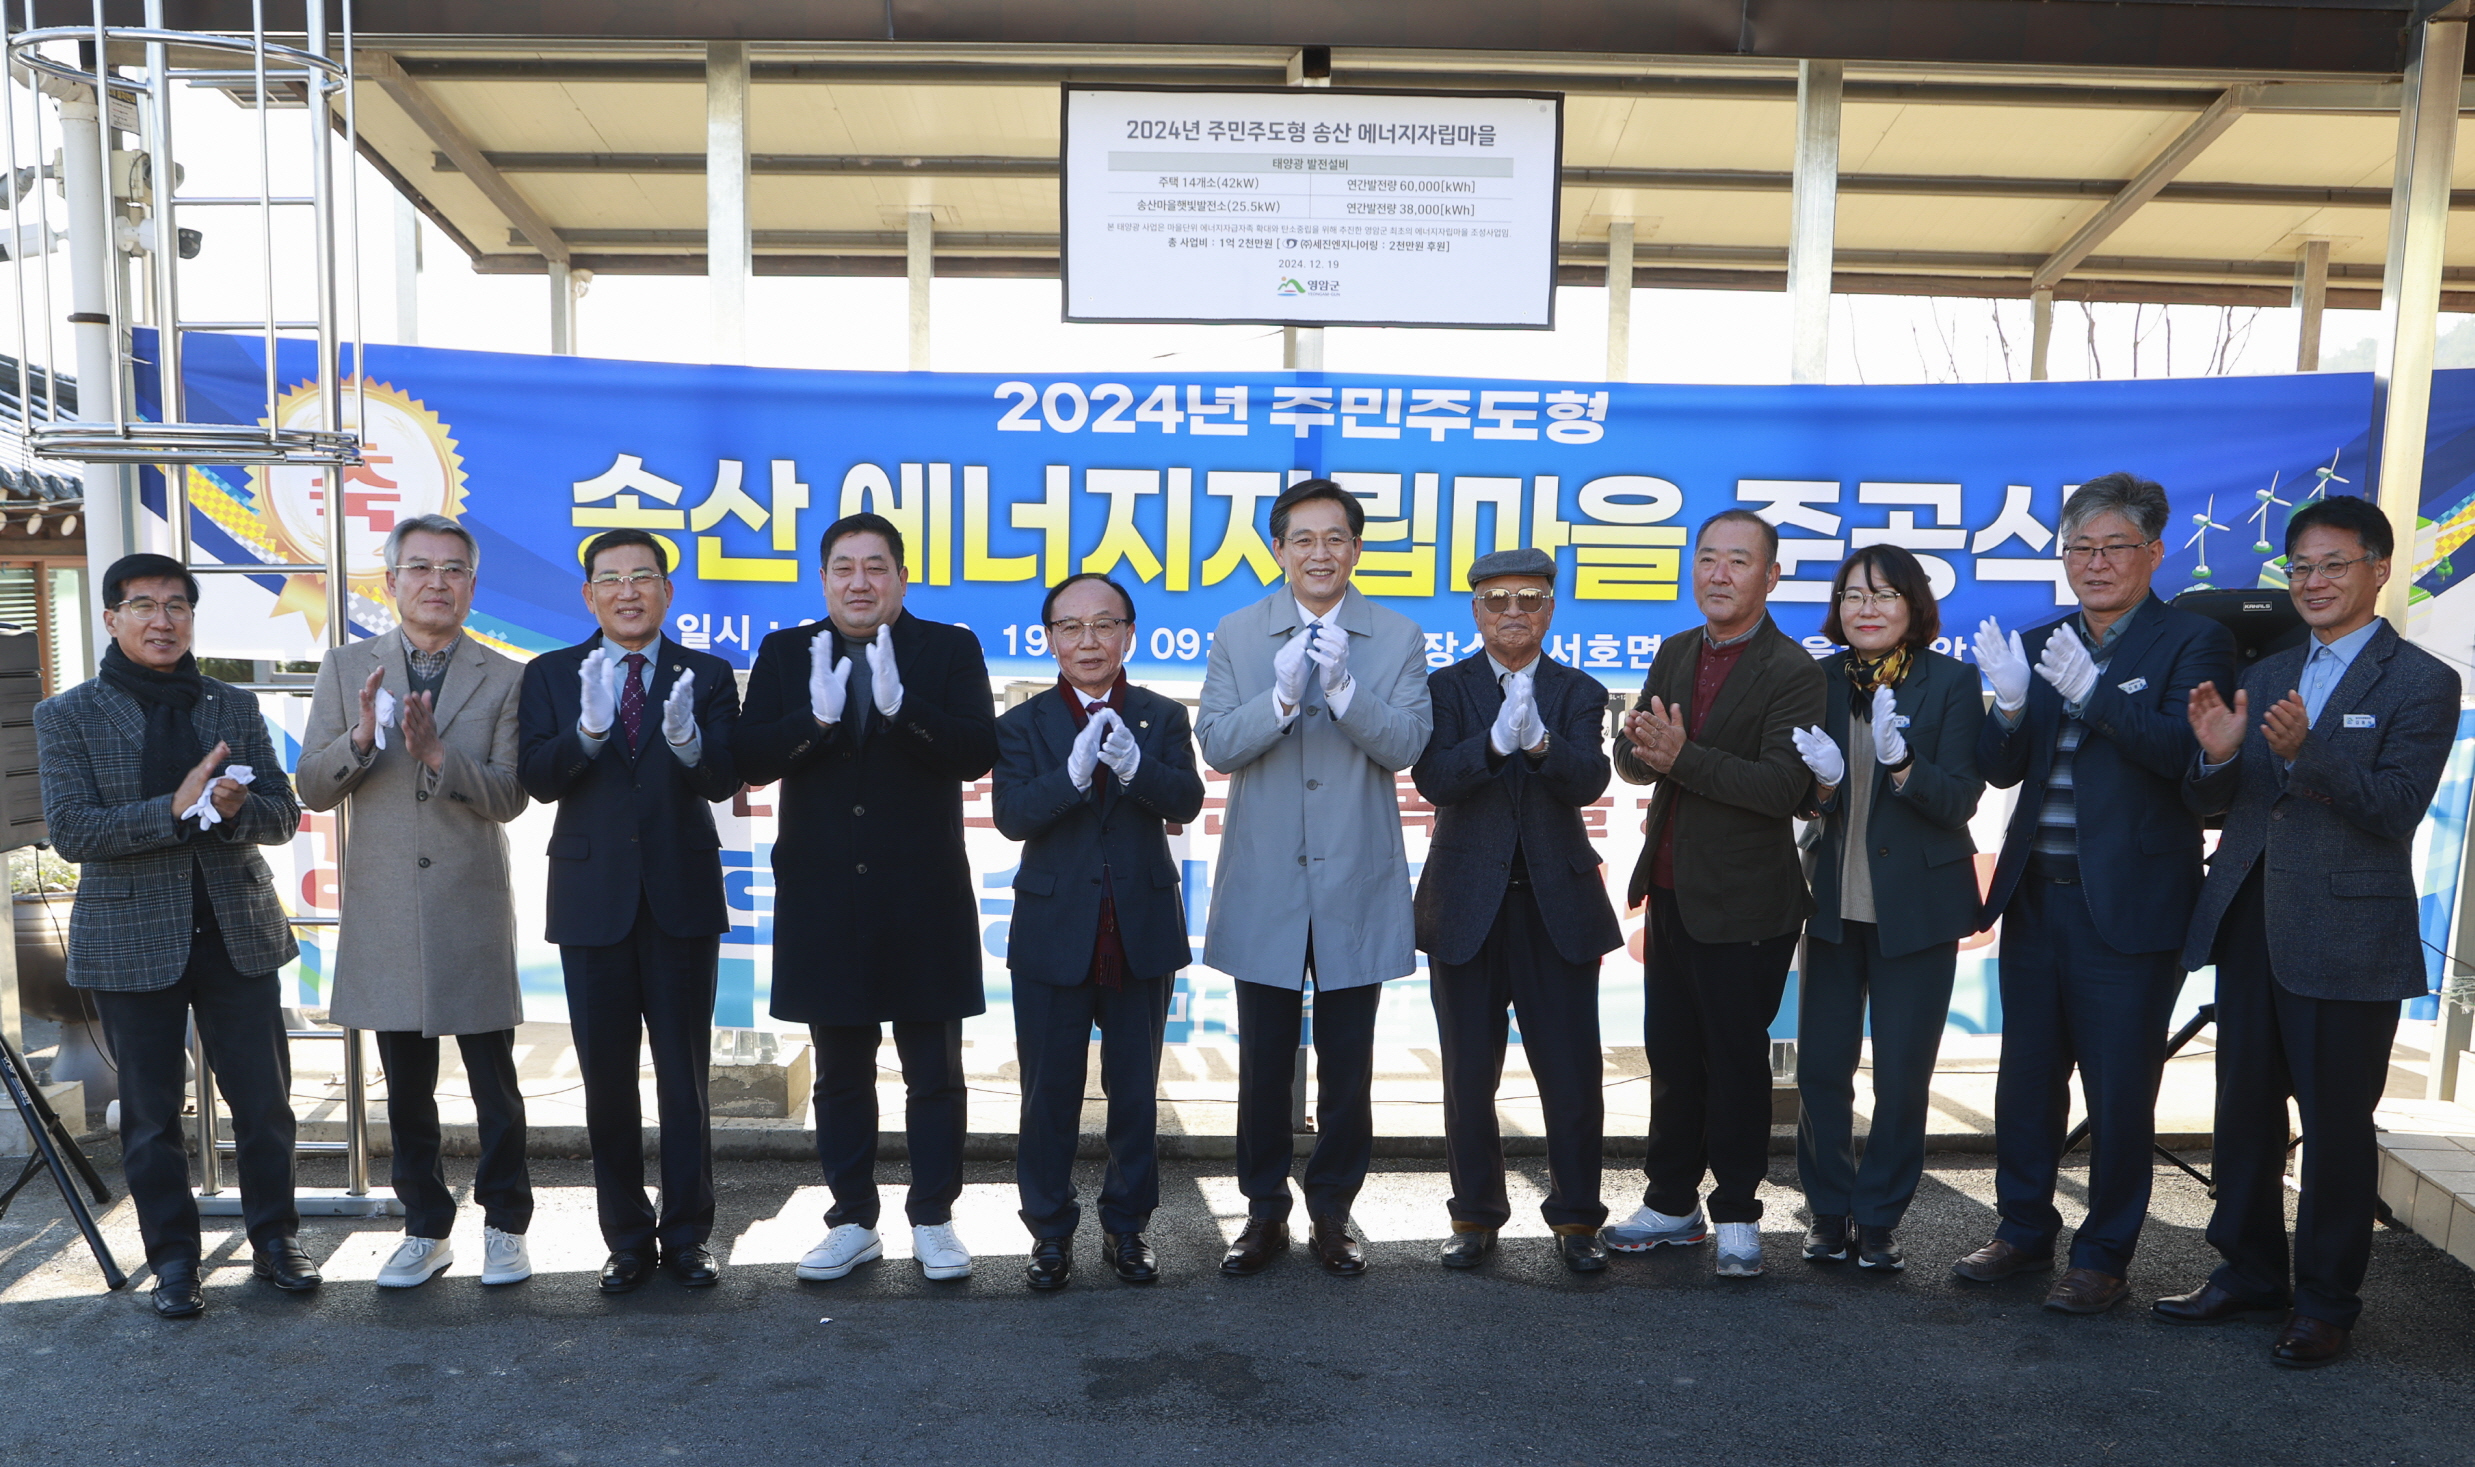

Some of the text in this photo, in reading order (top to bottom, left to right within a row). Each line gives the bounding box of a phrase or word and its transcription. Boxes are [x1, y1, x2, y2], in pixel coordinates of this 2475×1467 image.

[1126, 120, 1497, 147] 2024년 주민주도형 송산 에너지자립마을
[1272, 158, 1349, 171] 태양광 발전설비
[1158, 176, 1259, 189] 주택 14개소(42kW)
[1347, 179, 1476, 193] 연간발전량 60,000[kWh]
[1137, 199, 1281, 213] 송산마을햇빛발전소(25.5kW)
[1346, 203, 1475, 217] 연간발전량 38,000[kWh]
[1168, 237, 1177, 247] 총
[1180, 237, 1208, 248] 사업비
[1219, 238, 1235, 248] 1억
[1238, 238, 1273, 249] 2천만원
[1388, 240, 1424, 251] 2천만원
[1278, 259, 1340, 269] 2024. 12. 19
[1307, 280, 1340, 291] 영암군
[992, 381, 1610, 445] 2024년 주민주도형
[571, 453, 809, 582] 송산
[676, 613, 750, 651] 일시
[1550, 633, 1662, 669] 서호면
